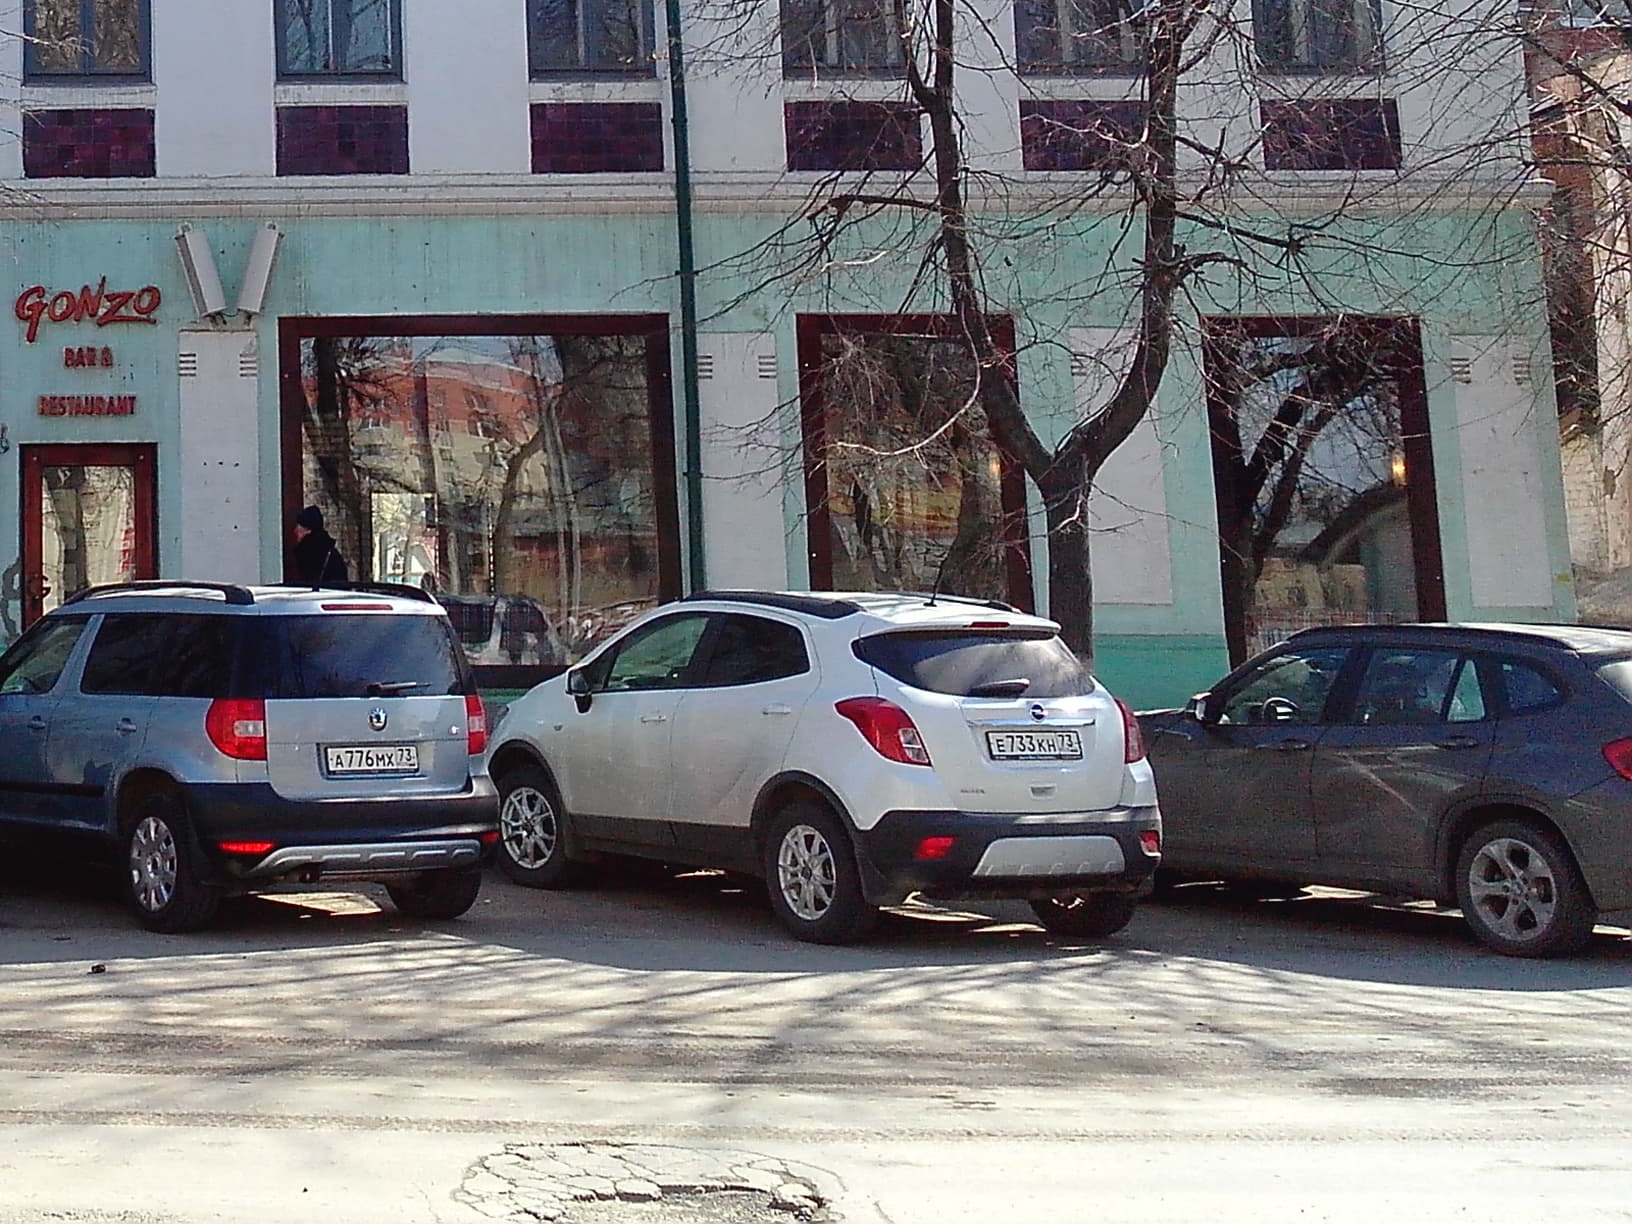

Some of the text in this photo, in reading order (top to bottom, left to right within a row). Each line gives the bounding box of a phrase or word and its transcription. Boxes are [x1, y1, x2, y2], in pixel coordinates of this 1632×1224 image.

[15, 275, 161, 343] GONZO
[64, 347, 96, 367] BAR
[39, 396, 136, 416] RESTAURANT
[397, 748, 412, 762] 73
